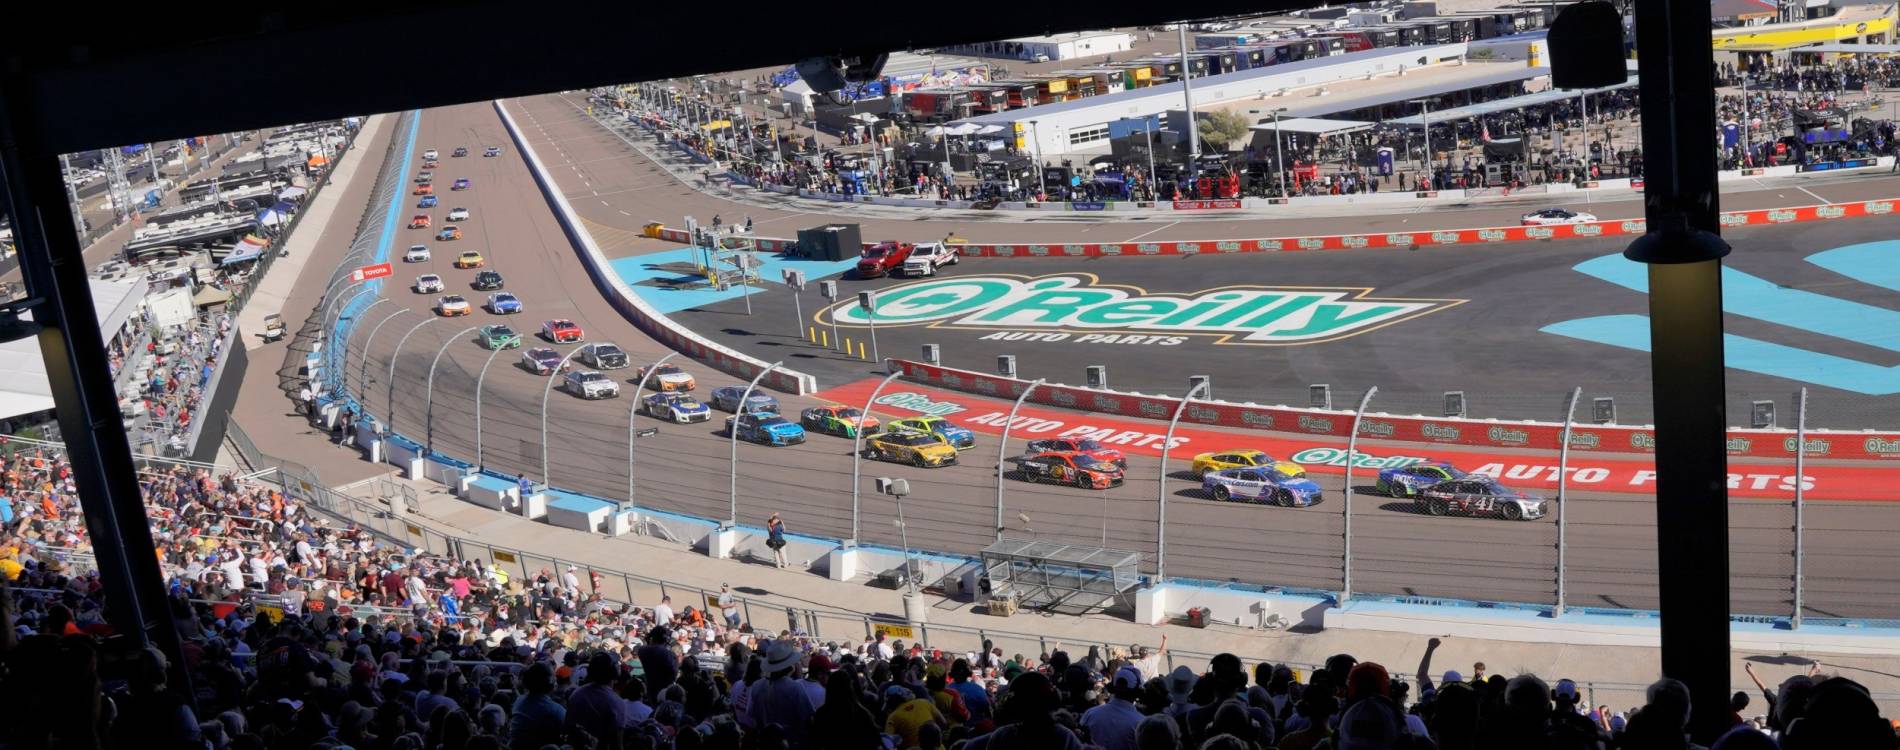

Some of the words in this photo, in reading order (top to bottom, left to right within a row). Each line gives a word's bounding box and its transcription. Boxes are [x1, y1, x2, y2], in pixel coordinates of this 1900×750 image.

[365, 268, 387, 276] TOYOTA
[834, 277, 1437, 340] O'Reilly
[978, 331, 1070, 343] AUTO
[1073, 332, 1189, 346] PARTS
[965, 411, 1064, 433] AUTO
[1057, 425, 1190, 449] PARTS
[1423, 423, 1459, 439] O'Reilly
[1488, 426, 1529, 443] O'Reilly
[1632, 434, 1655, 447] O'Re
[1784, 437, 1830, 453] Oeilly
[1864, 438, 1900, 453] O'Reil
[1292, 447, 1429, 469] O'Reill
[1470, 463, 1610, 483] AUTO
[1629, 470, 1816, 491] PTS
[1475, 497, 1495, 511] 41
